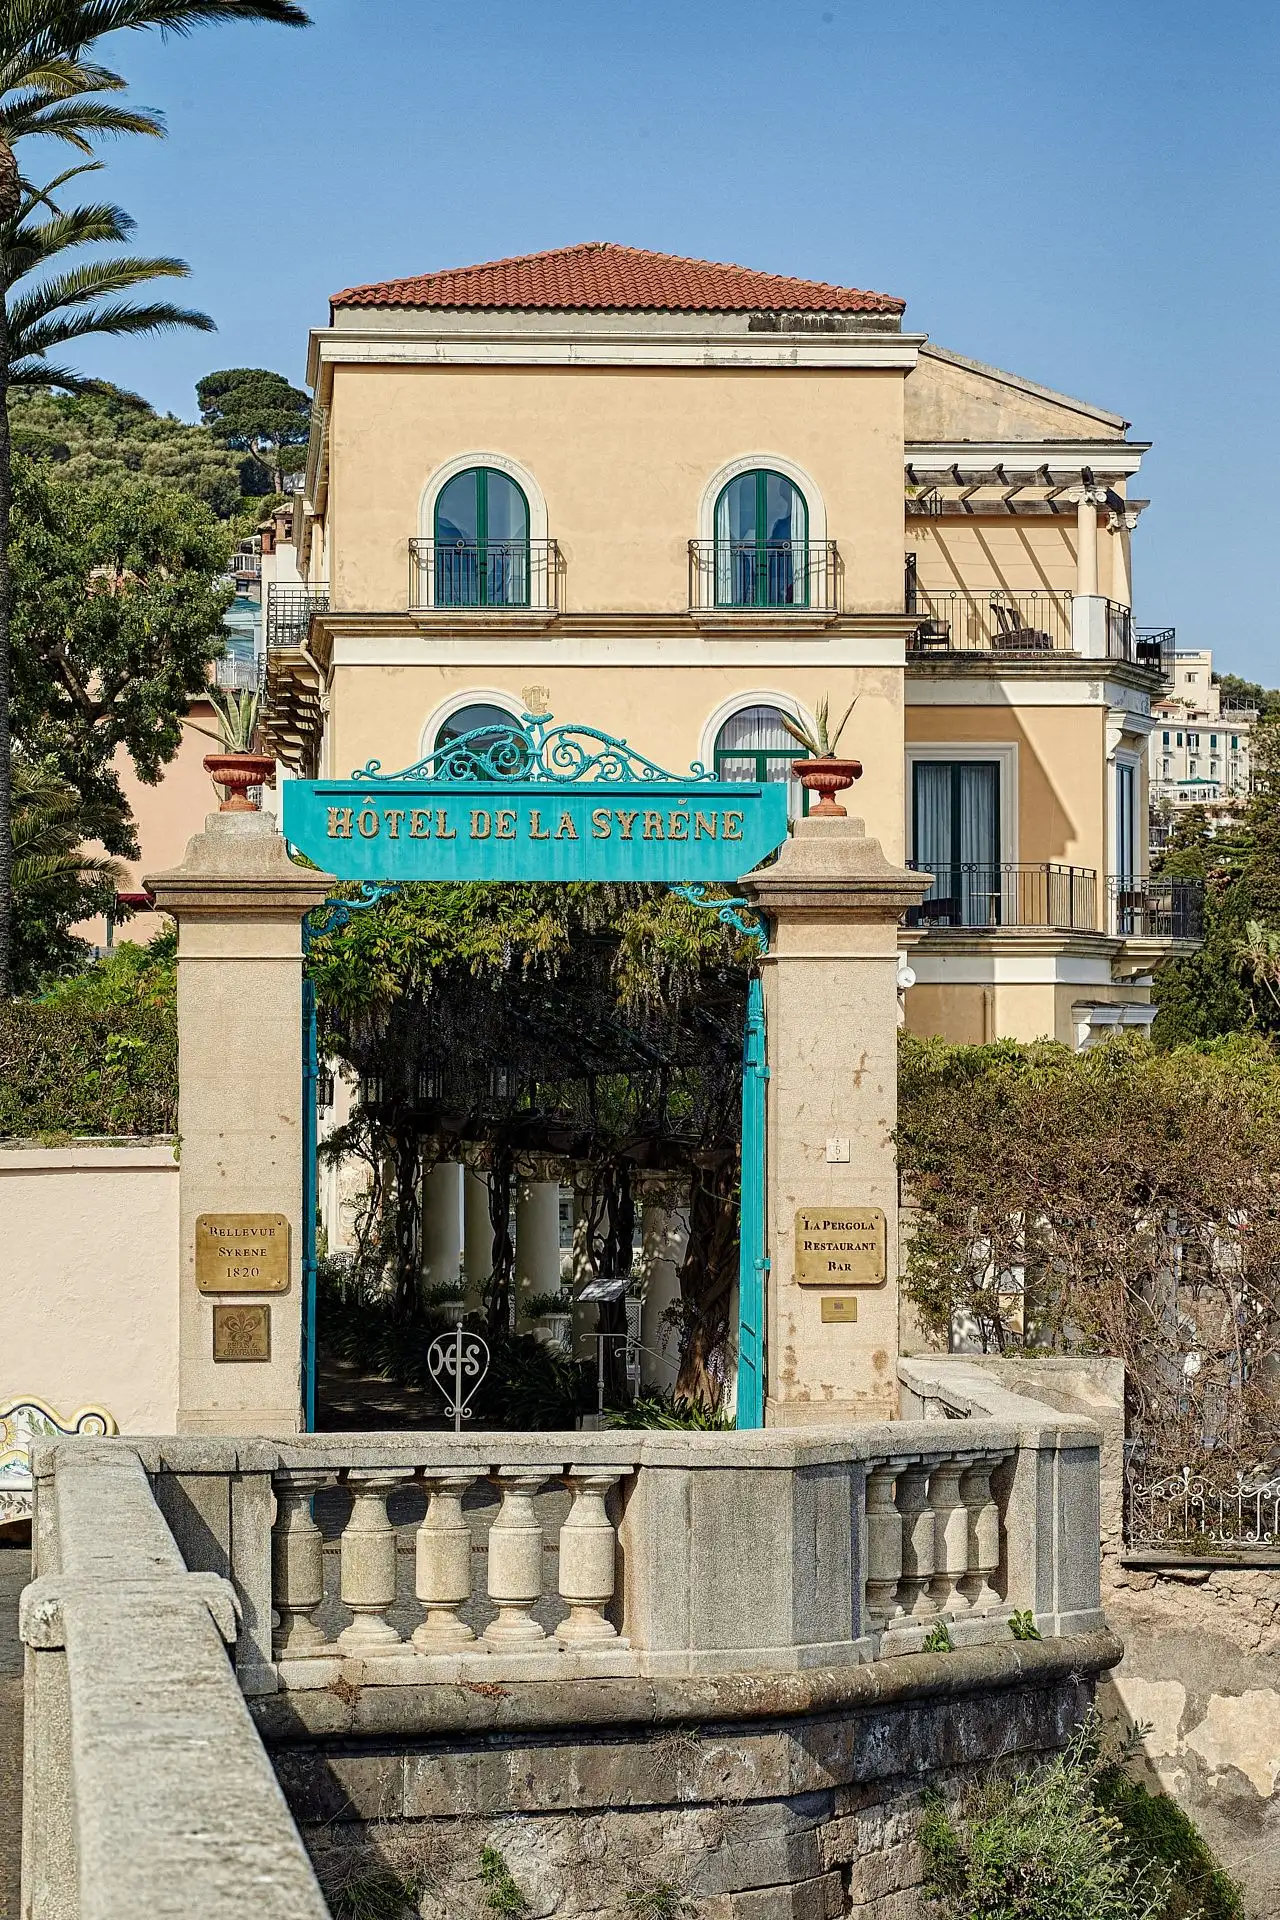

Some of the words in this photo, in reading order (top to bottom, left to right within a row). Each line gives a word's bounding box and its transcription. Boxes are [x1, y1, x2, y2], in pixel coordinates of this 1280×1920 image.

[326, 796, 457, 839] HÔTEL
[469, 809, 518, 840] DE
[528, 809, 580, 840] LA
[804, 1220, 821, 1231] LA
[823, 1220, 875, 1231] PERGOLA
[209, 1226, 276, 1237] BELLEVUE
[804, 1240, 876, 1251] RESTAURANT
[218, 1246, 267, 1257] SYRENE
[828, 1260, 852, 1272] BAR
[227, 1267, 259, 1278] 1820
